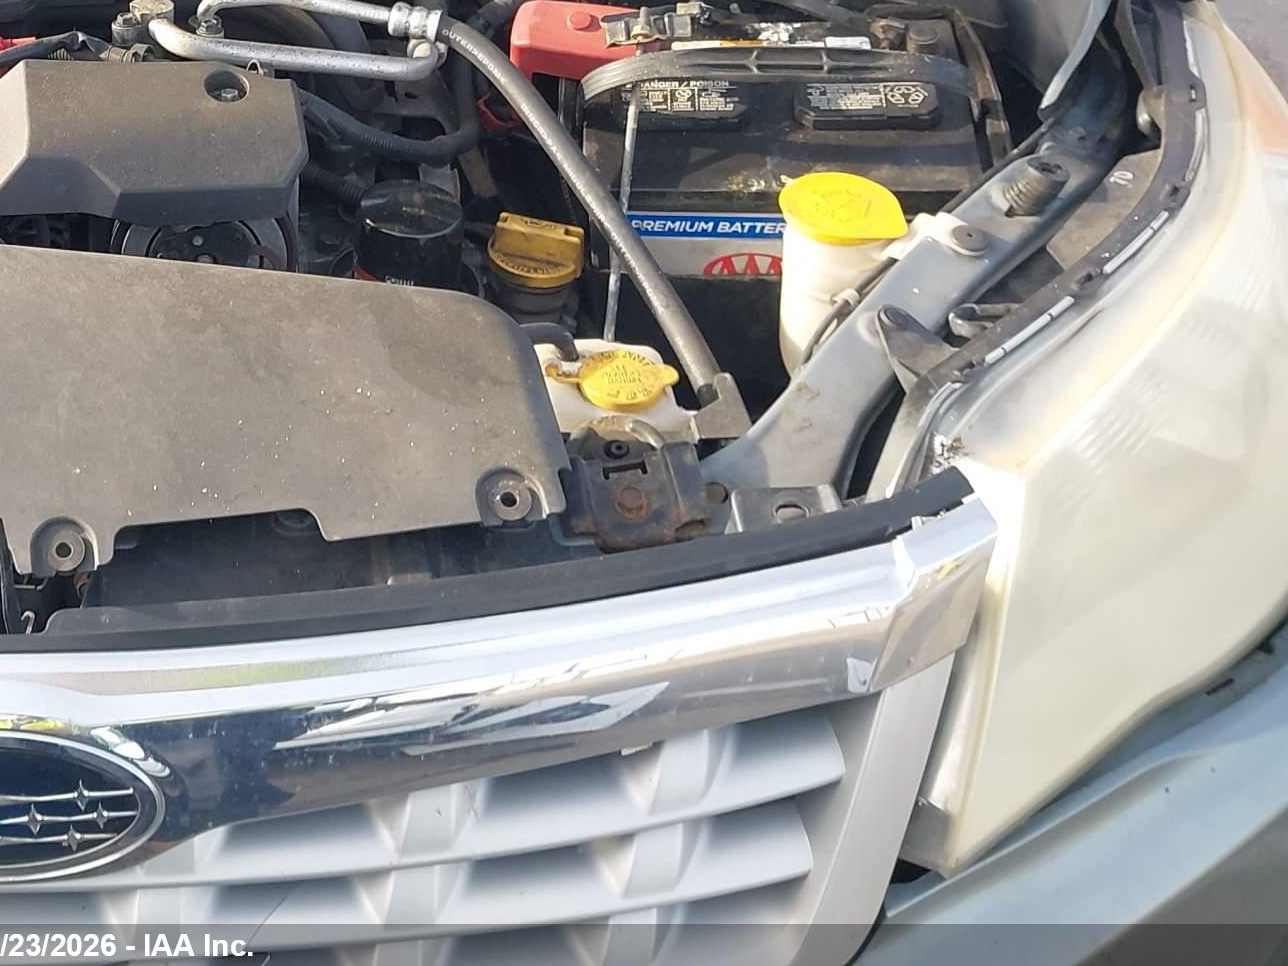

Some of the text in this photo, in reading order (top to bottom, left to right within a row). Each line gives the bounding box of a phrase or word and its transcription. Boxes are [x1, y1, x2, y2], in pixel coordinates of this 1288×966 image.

[641, 80, 679, 89] ANGER
[631, 220, 787, 234] PREMIUM BATTER
